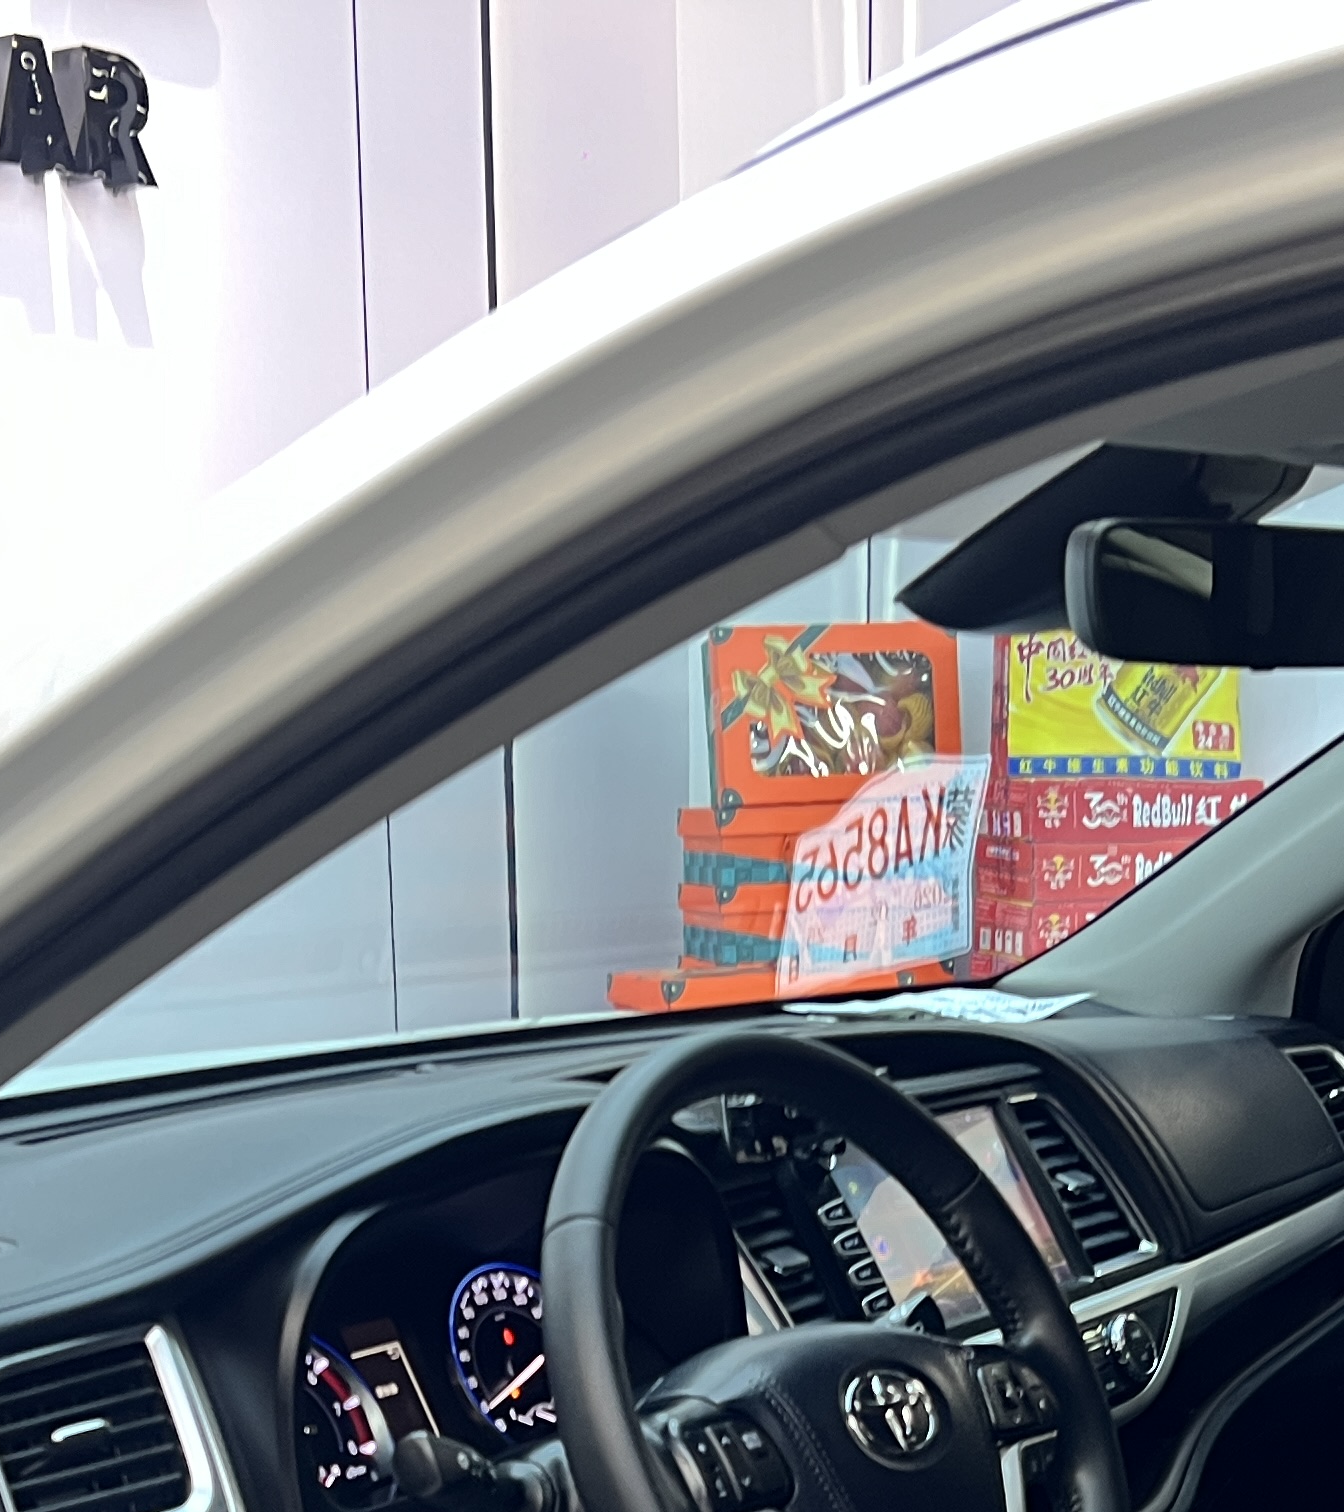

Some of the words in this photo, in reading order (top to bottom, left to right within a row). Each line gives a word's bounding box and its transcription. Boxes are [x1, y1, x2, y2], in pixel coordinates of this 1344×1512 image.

[1019, 758, 1230, 778] 红牛维生素功能饮料
[1132, 792, 1194, 829] RedBull
